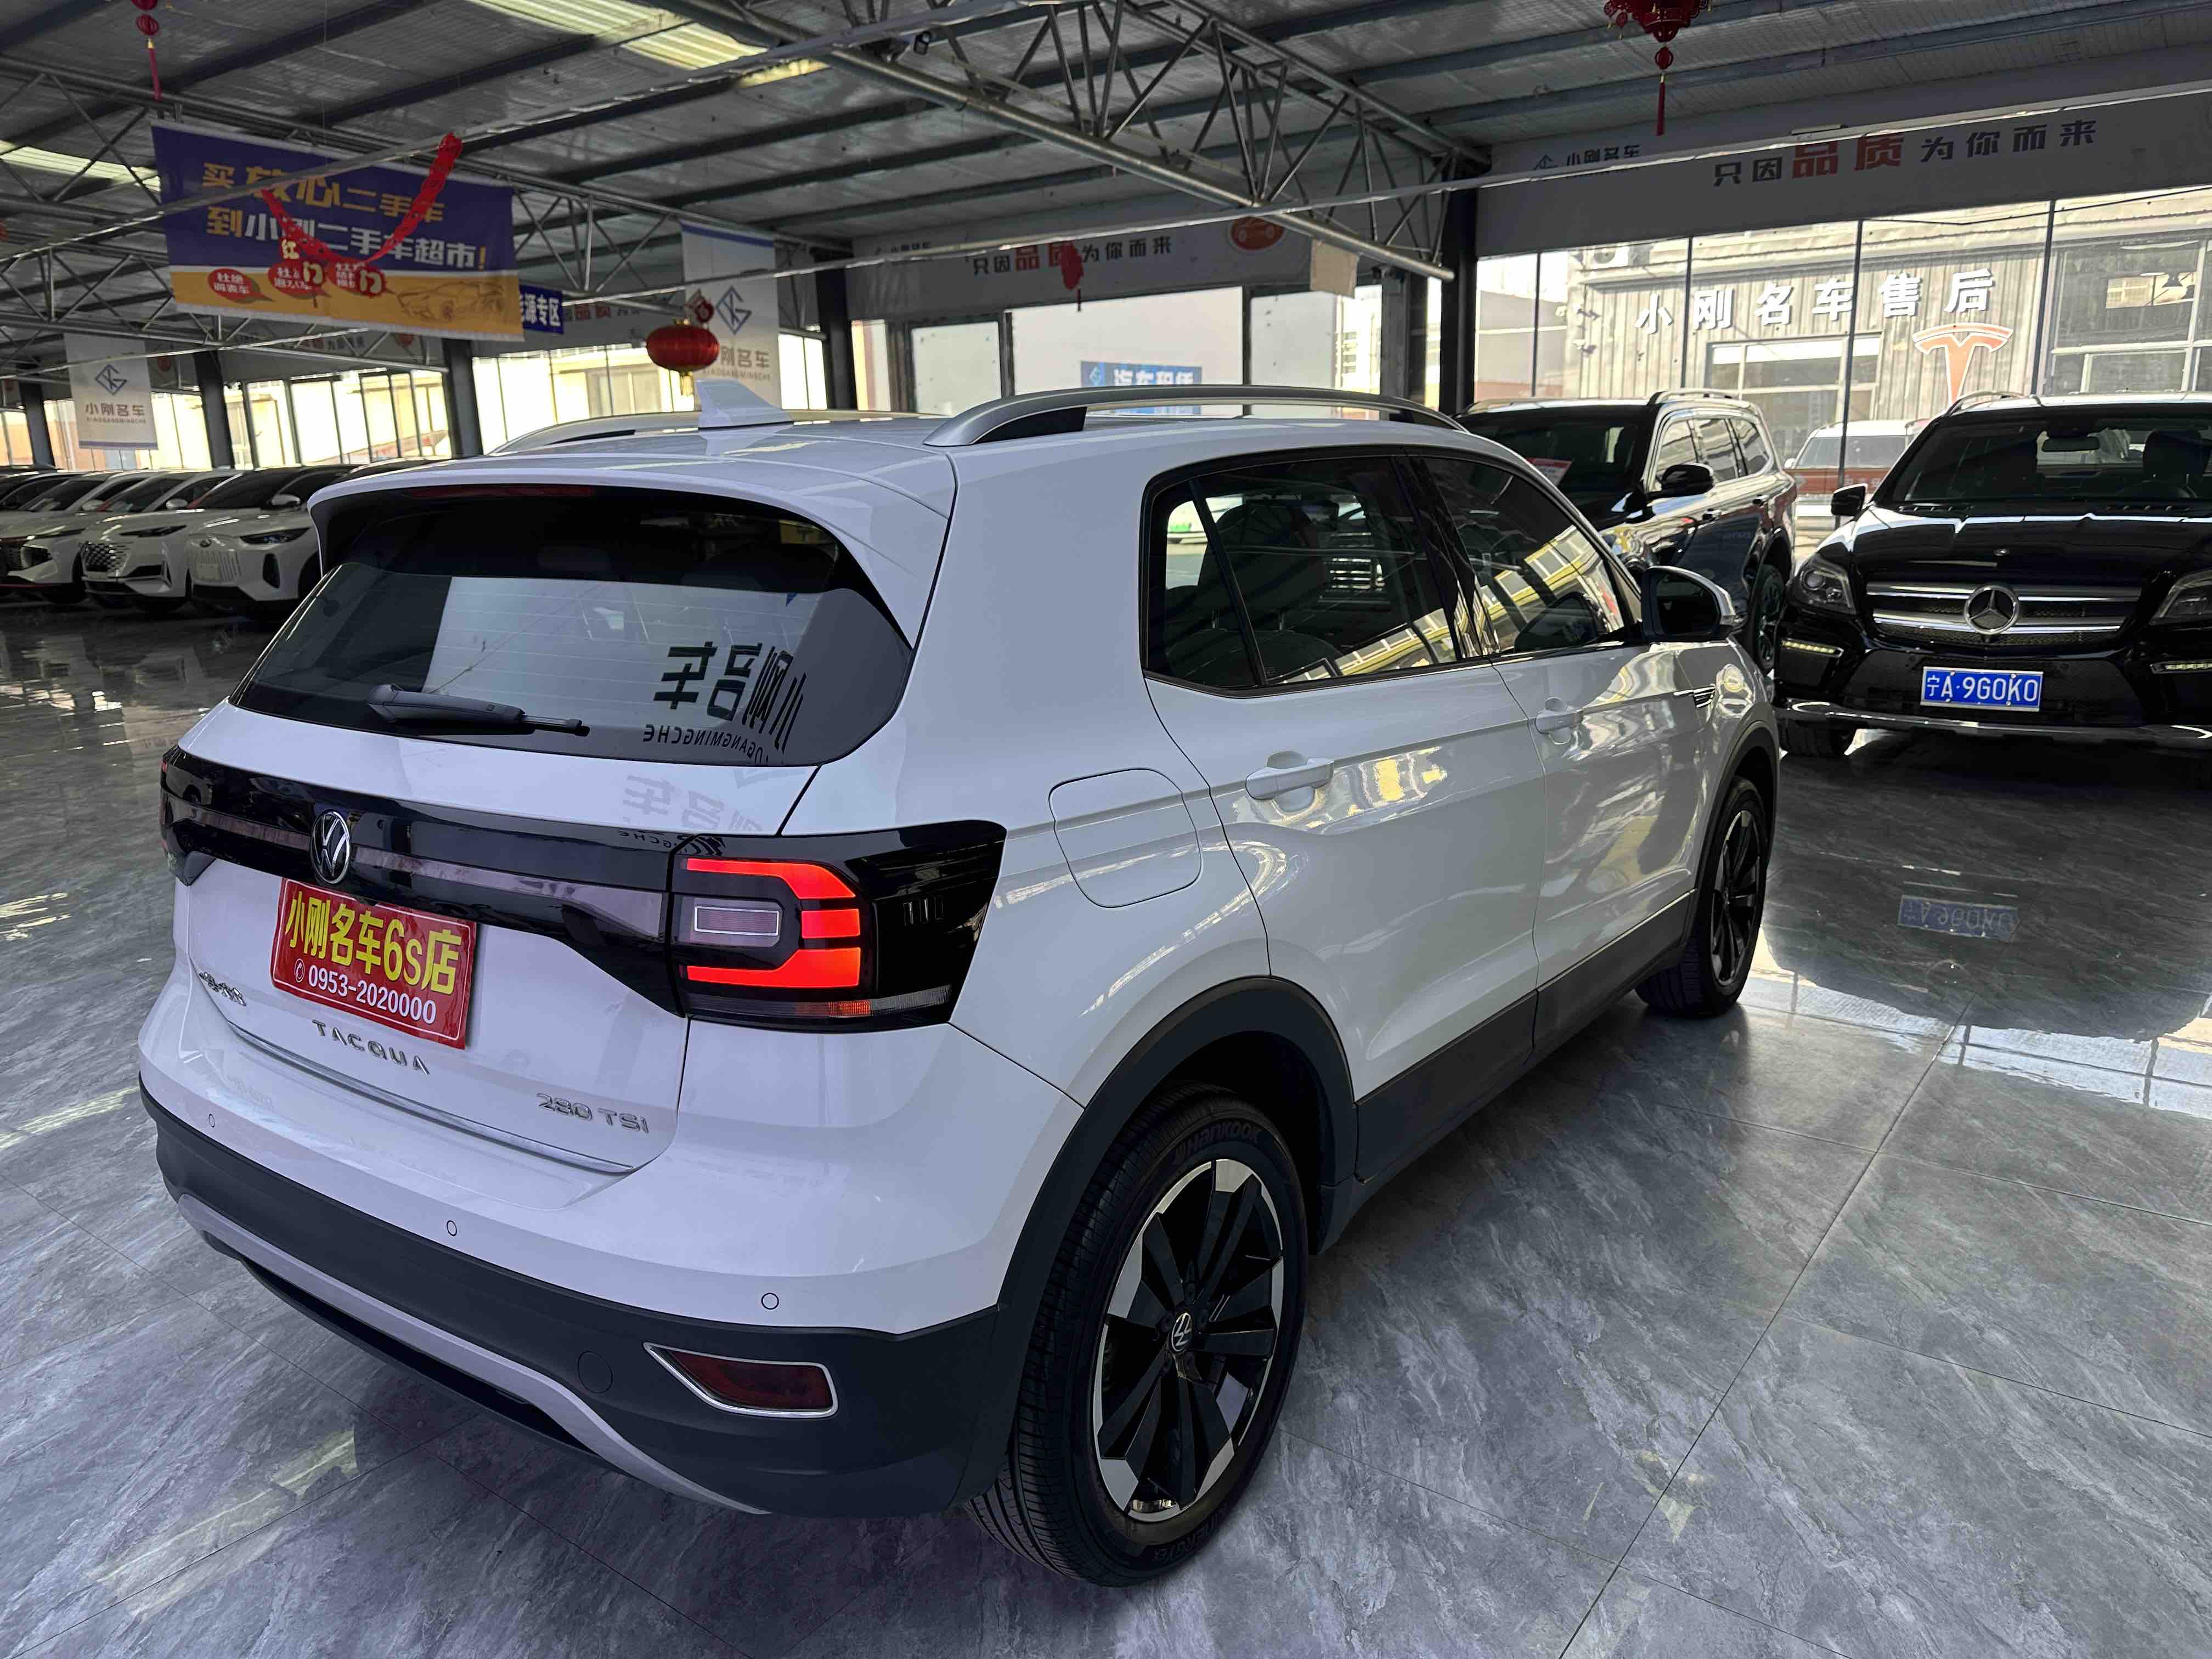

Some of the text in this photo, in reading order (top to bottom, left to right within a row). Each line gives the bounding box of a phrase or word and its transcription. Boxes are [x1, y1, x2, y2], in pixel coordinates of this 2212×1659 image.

[1567, 144, 1640, 166] 小刚名车
[1713, 119, 2097, 187] 只因品质为你而来
[201, 163, 445, 223] 买放心二手车
[973, 236, 1171, 275] 只因品质为你而来
[1635, 268, 1994, 335] 小刚名车售后
[720, 342, 770, 368] 刚名车
[84, 402, 145, 416] 小刚名车
[308, 964, 437, 1025] 0953-2020000
[312, 1019, 430, 1075] TACQUA
[536, 1092, 594, 1121] 280
